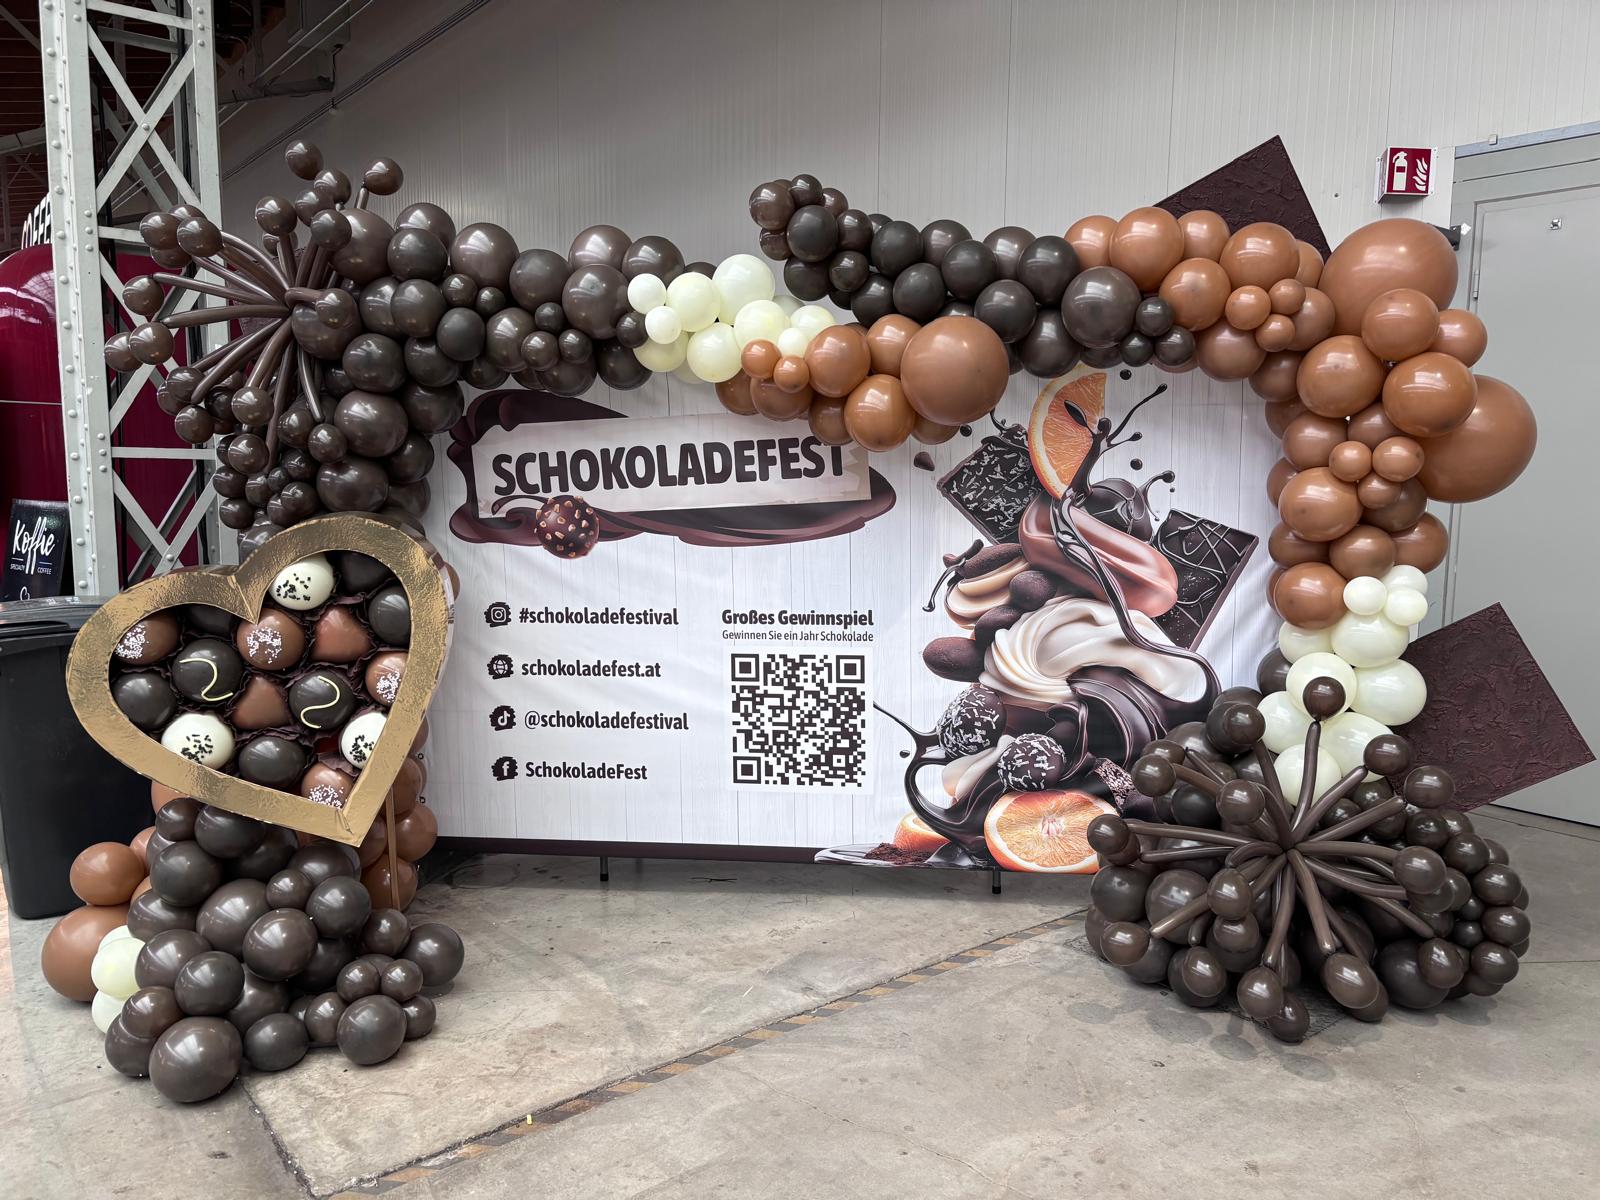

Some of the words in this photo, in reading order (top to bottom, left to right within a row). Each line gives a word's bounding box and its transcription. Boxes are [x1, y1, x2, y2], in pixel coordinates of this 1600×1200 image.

[491, 435, 843, 497] SCHOKOLADEFEST
[12, 516, 55, 575] Koffie
[37, 567, 52, 575] COFFEE
[518, 606, 680, 626] #schokoladefestival
[721, 609, 775, 625] Großes
[777, 609, 875, 630] Gewinnspiel
[722, 629, 767, 640] Gewinnen
[768, 630, 783, 641] Sie
[783, 630, 798, 641] ein
[799, 630, 820, 642] Jahr
[820, 630, 874, 642] Schokolade
[521, 658, 662, 678] schokoladefest.at
[524, 709, 689, 731] @schokoladefestival
[525, 760, 648, 780] SchokoladeFest
